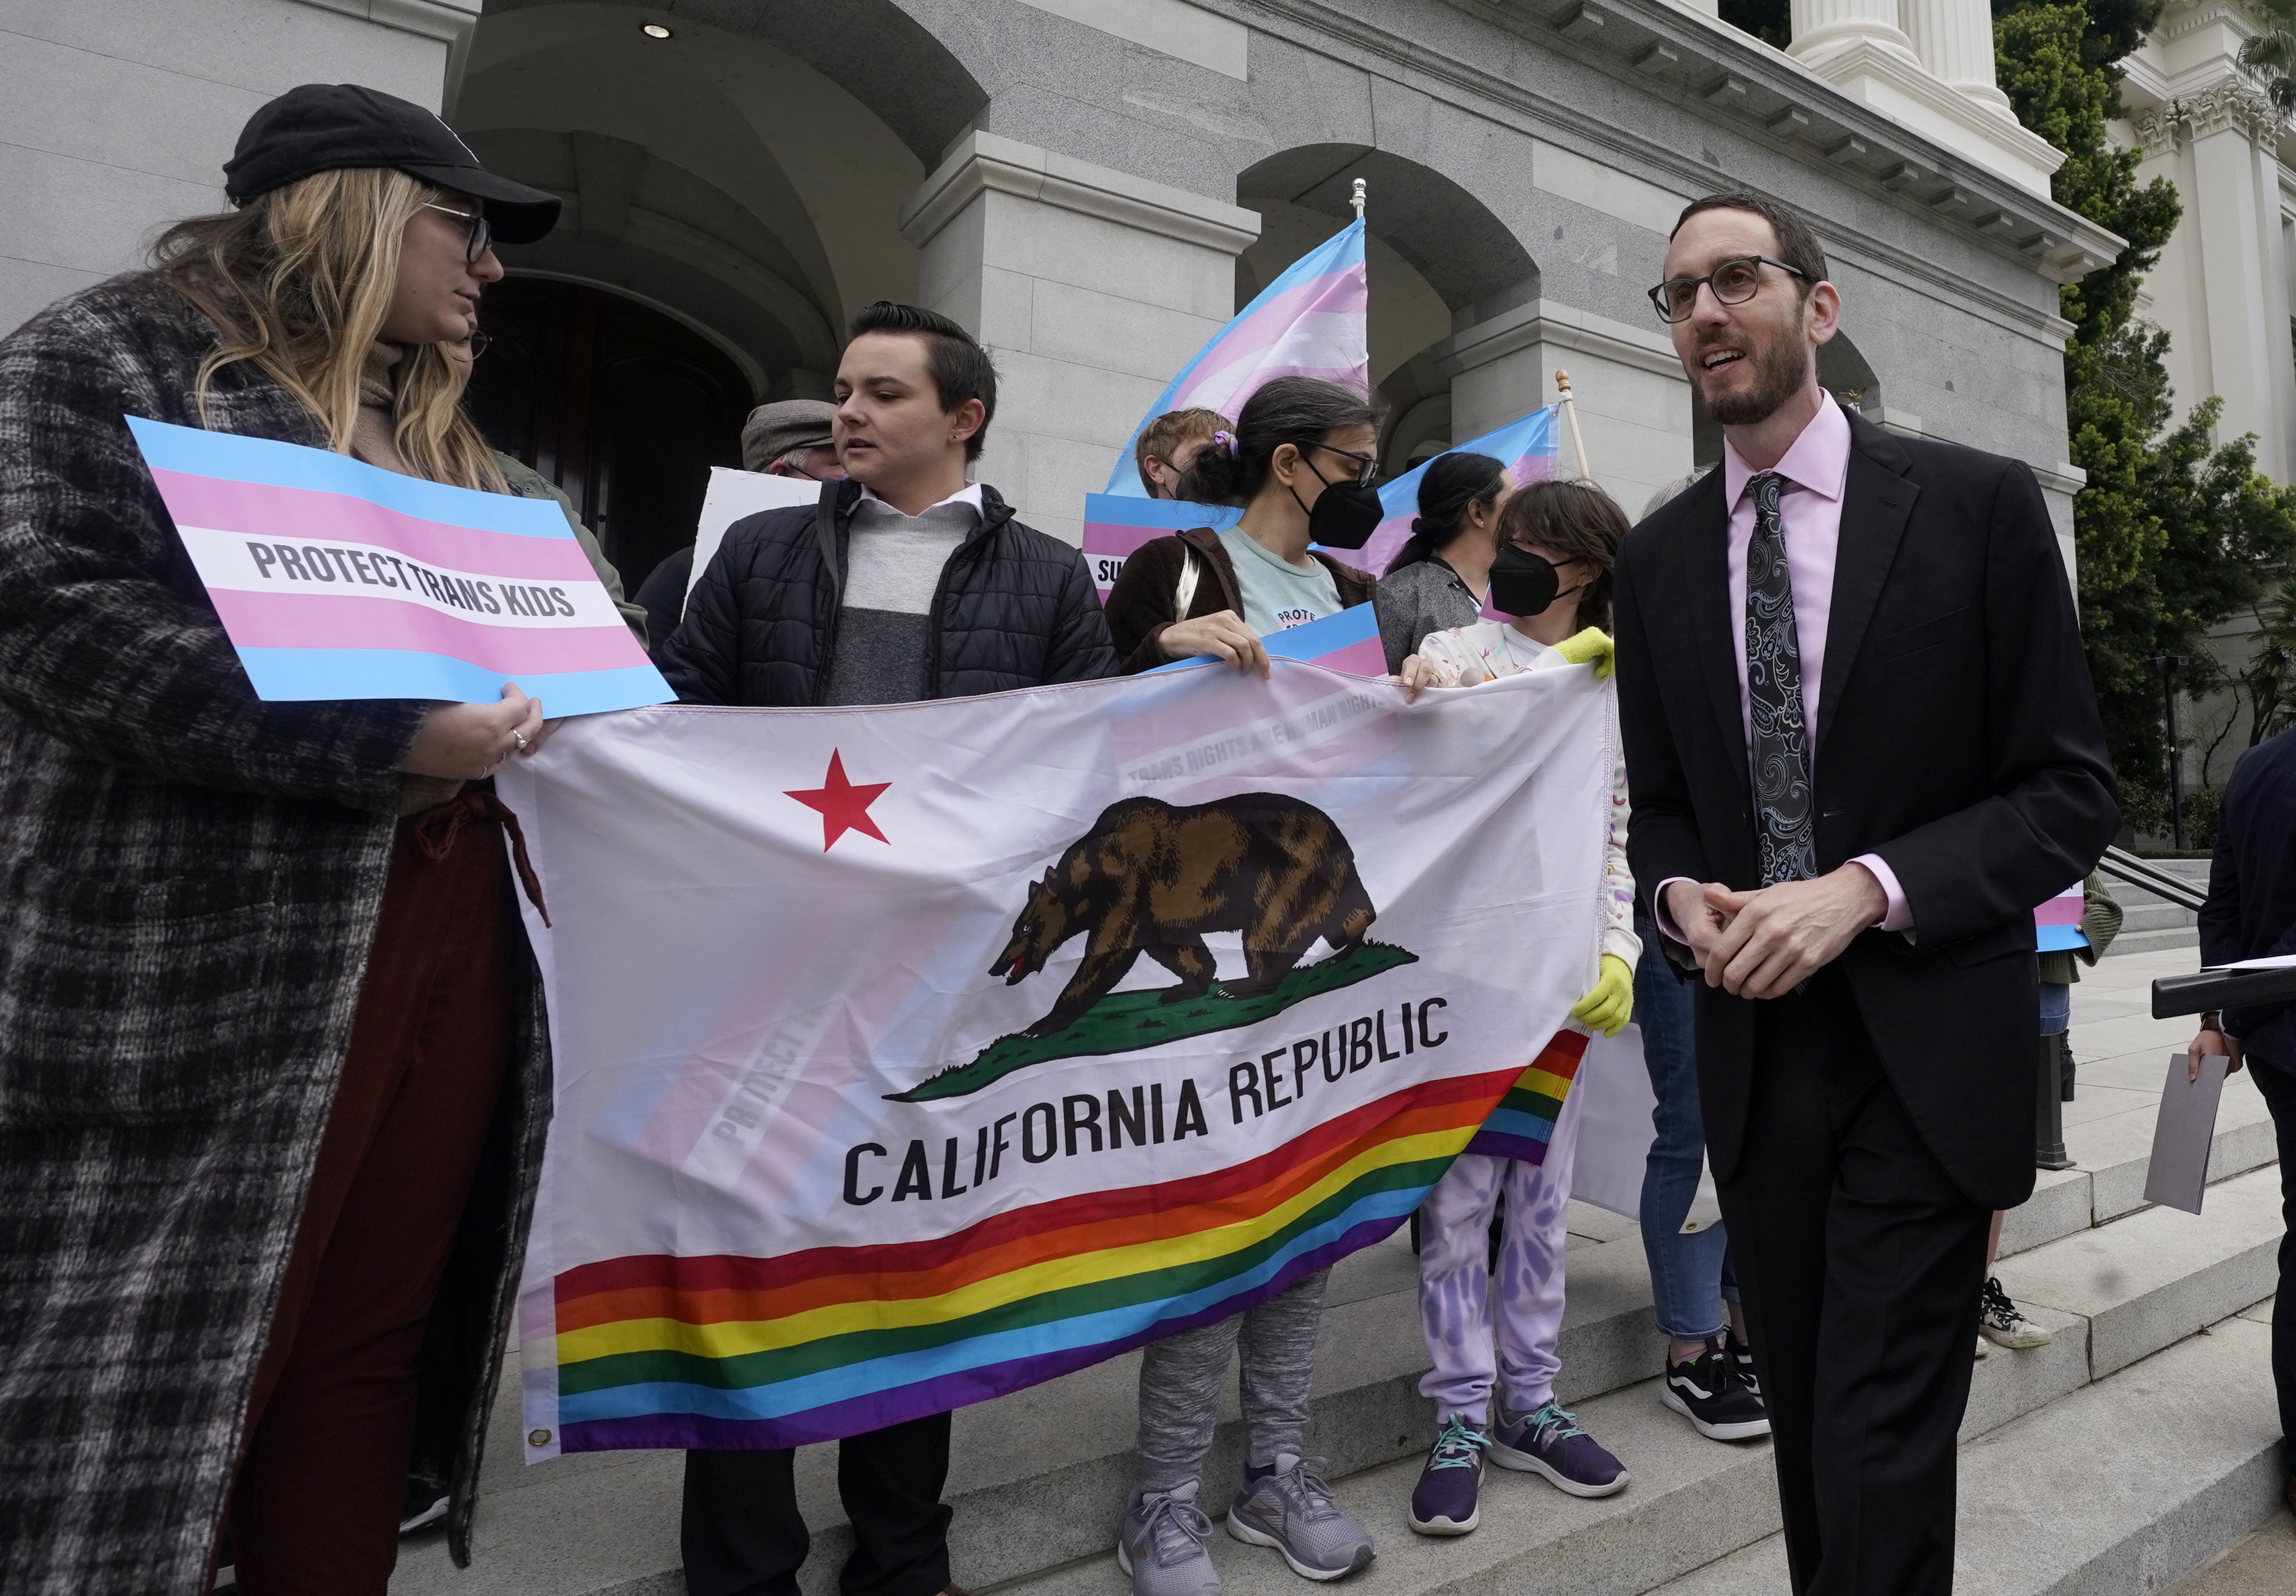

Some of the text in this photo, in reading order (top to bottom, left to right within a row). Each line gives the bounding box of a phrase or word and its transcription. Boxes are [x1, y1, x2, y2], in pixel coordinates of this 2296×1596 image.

[246, 541, 575, 617] PROTECT TRANS KIDS
[1128, 755, 1184, 787] TRANS
[1185, 736, 1248, 772] RIGHTS
[843, 997, 1448, 1206] CALIFORNIA REPUBLIC
